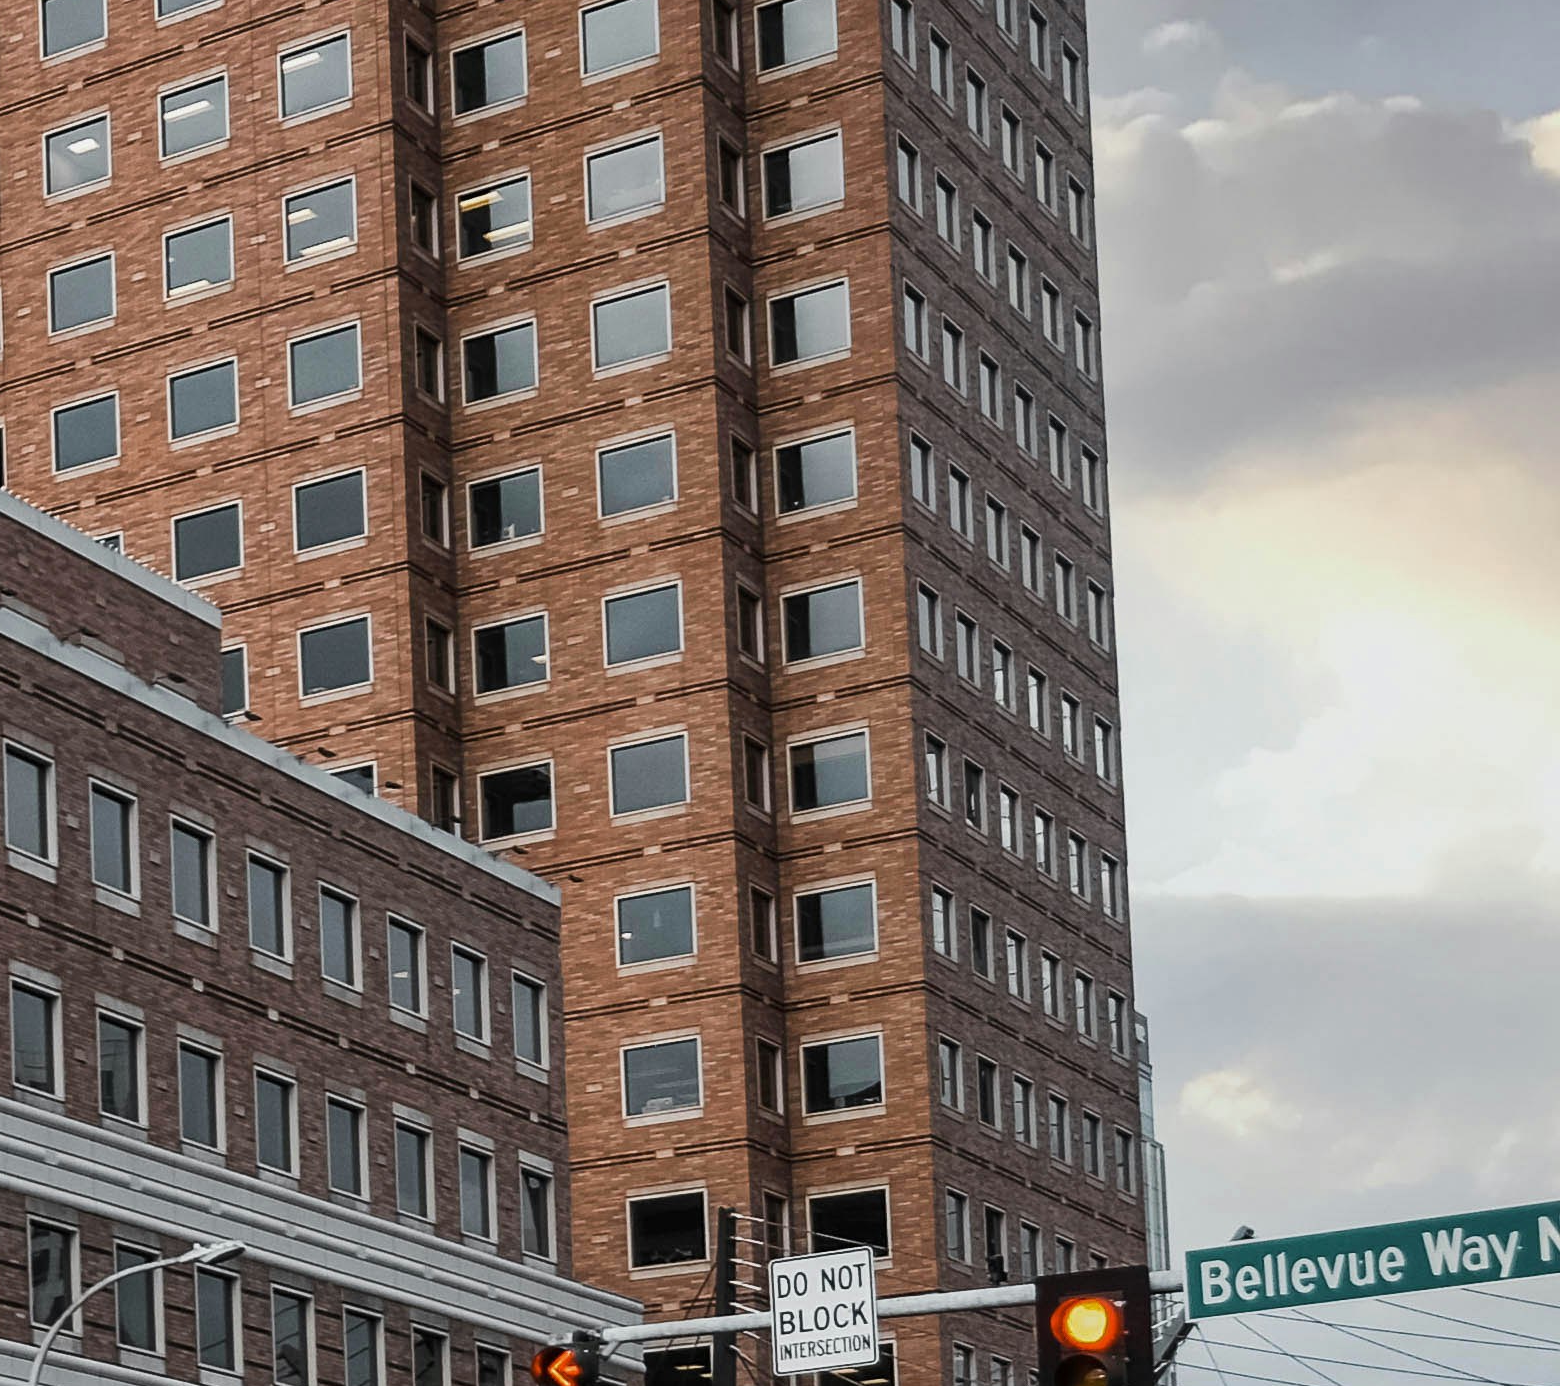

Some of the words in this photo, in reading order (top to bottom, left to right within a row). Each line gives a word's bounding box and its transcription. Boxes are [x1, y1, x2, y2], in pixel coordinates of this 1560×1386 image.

[777, 1271, 808, 1298] DO
[821, 1263, 866, 1293] NOT
[1200, 1245, 1407, 1306] Bellevue
[1422, 1227, 1520, 1279] Way
[780, 1301, 868, 1335] BLOCK
[780, 1334, 871, 1361] INTERSECTION
